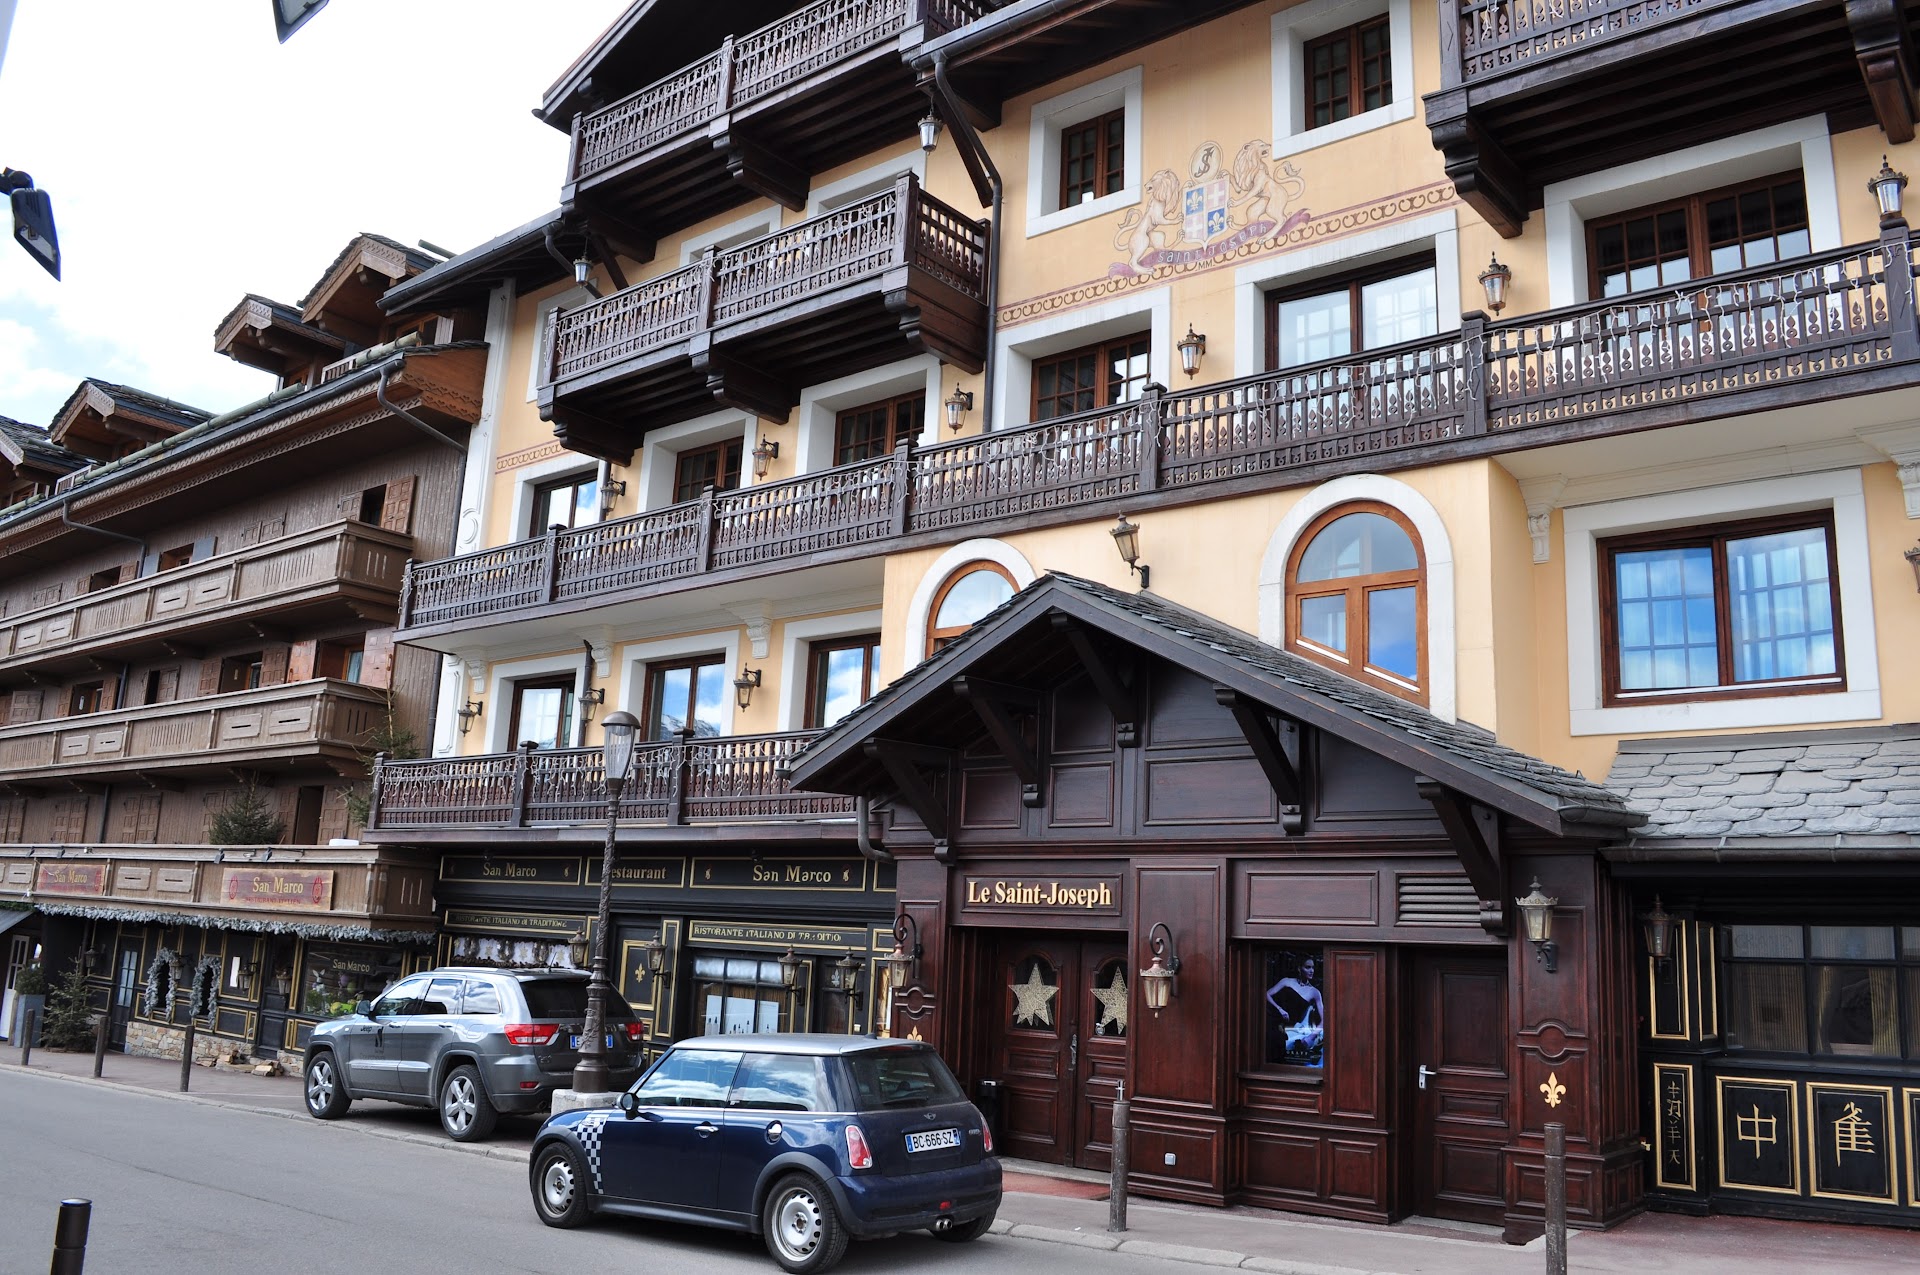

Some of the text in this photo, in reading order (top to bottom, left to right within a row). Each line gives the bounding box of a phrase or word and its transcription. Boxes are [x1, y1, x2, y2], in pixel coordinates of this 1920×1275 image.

[54, 868, 88, 884] San Marco
[483, 861, 537, 877] San Marco
[611, 866, 667, 880] estaurant
[753, 865, 831, 883] San Marco
[252, 876, 304, 894] San Marco
[968, 881, 1112, 908] Le Saint-Joseph
[492, 916, 520, 926] ITALIANO
[694, 926, 744, 938] RISTORANTE
[745, 929, 785, 940] ITALIANO
[787, 931, 796, 940] DI
[332, 958, 371, 973] San Marco
[1736, 1103, 1777, 1160] 中
